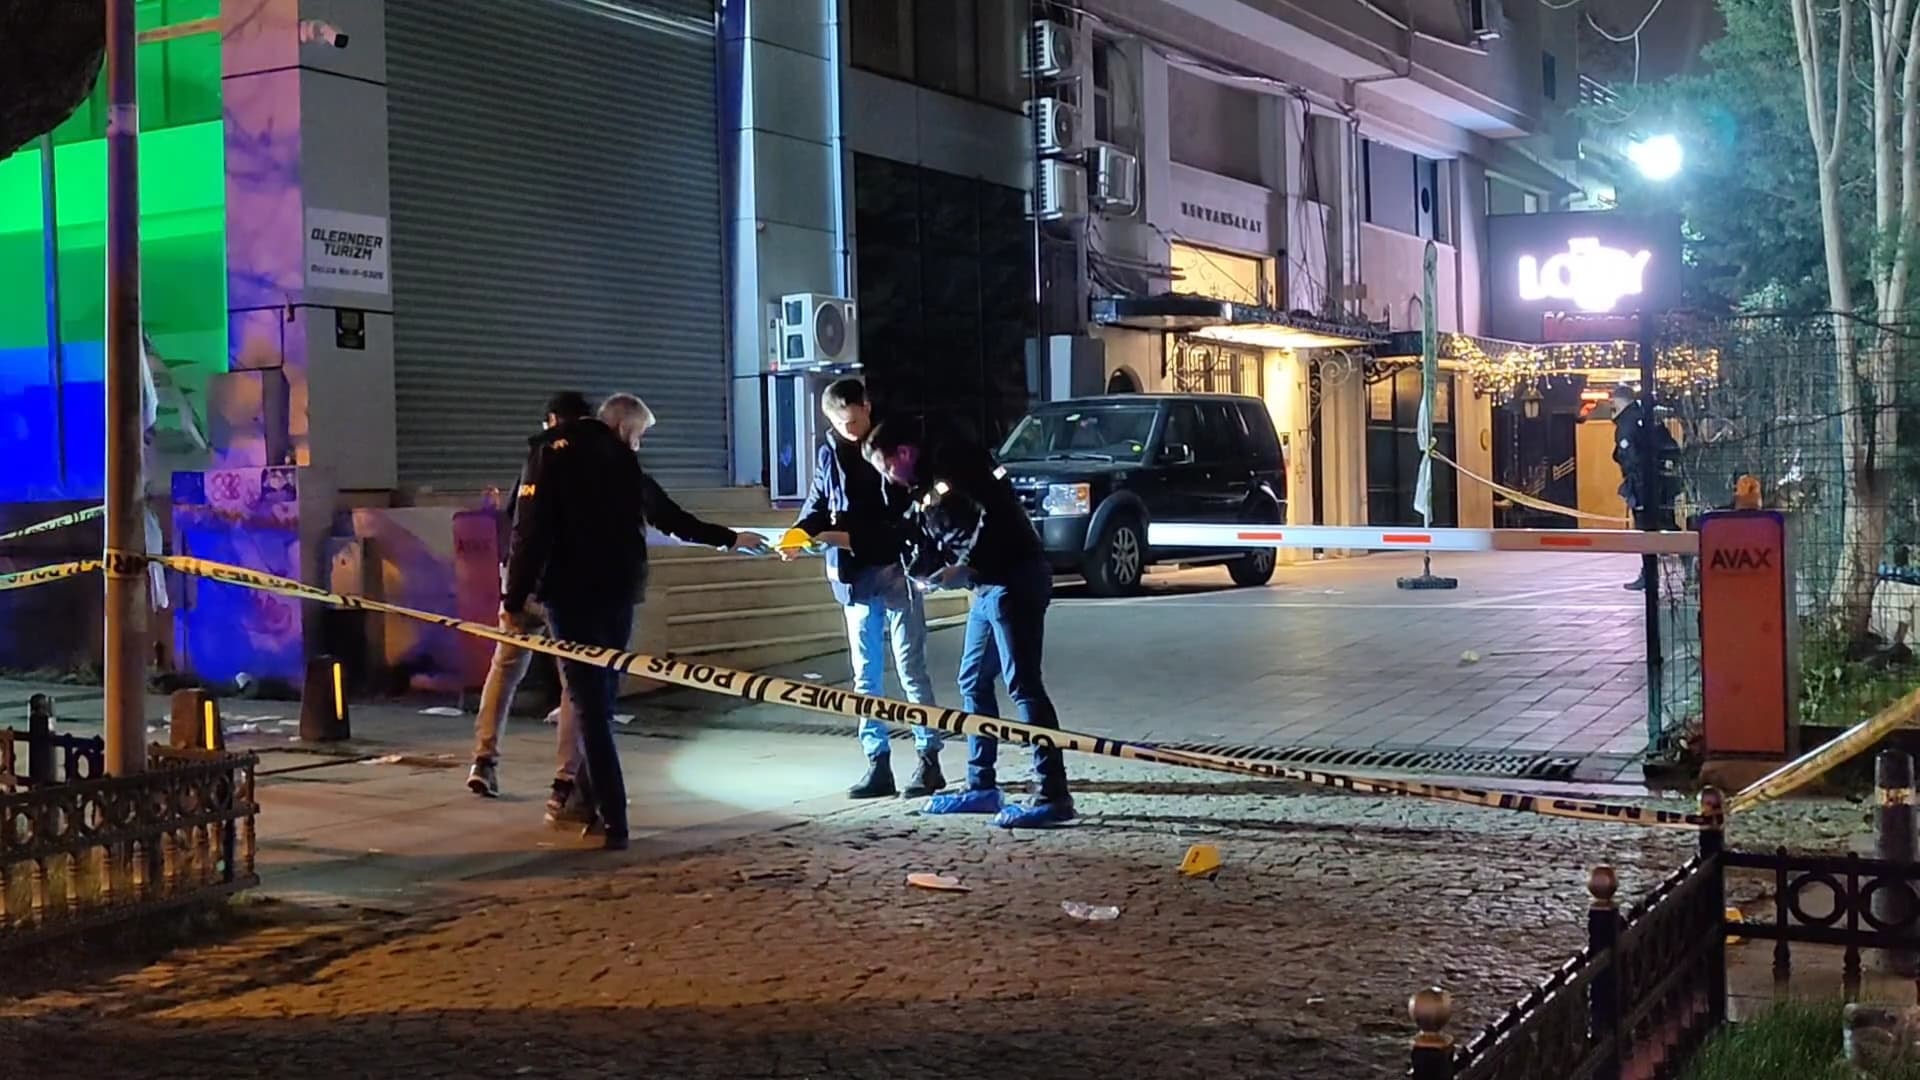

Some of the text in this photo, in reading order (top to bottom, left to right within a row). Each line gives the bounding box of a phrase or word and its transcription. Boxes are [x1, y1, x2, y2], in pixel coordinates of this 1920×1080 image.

[311, 227, 383, 248] OLEANDER
[1519, 240, 1651, 311] LOY
[1710, 548, 1772, 569] AVAX
